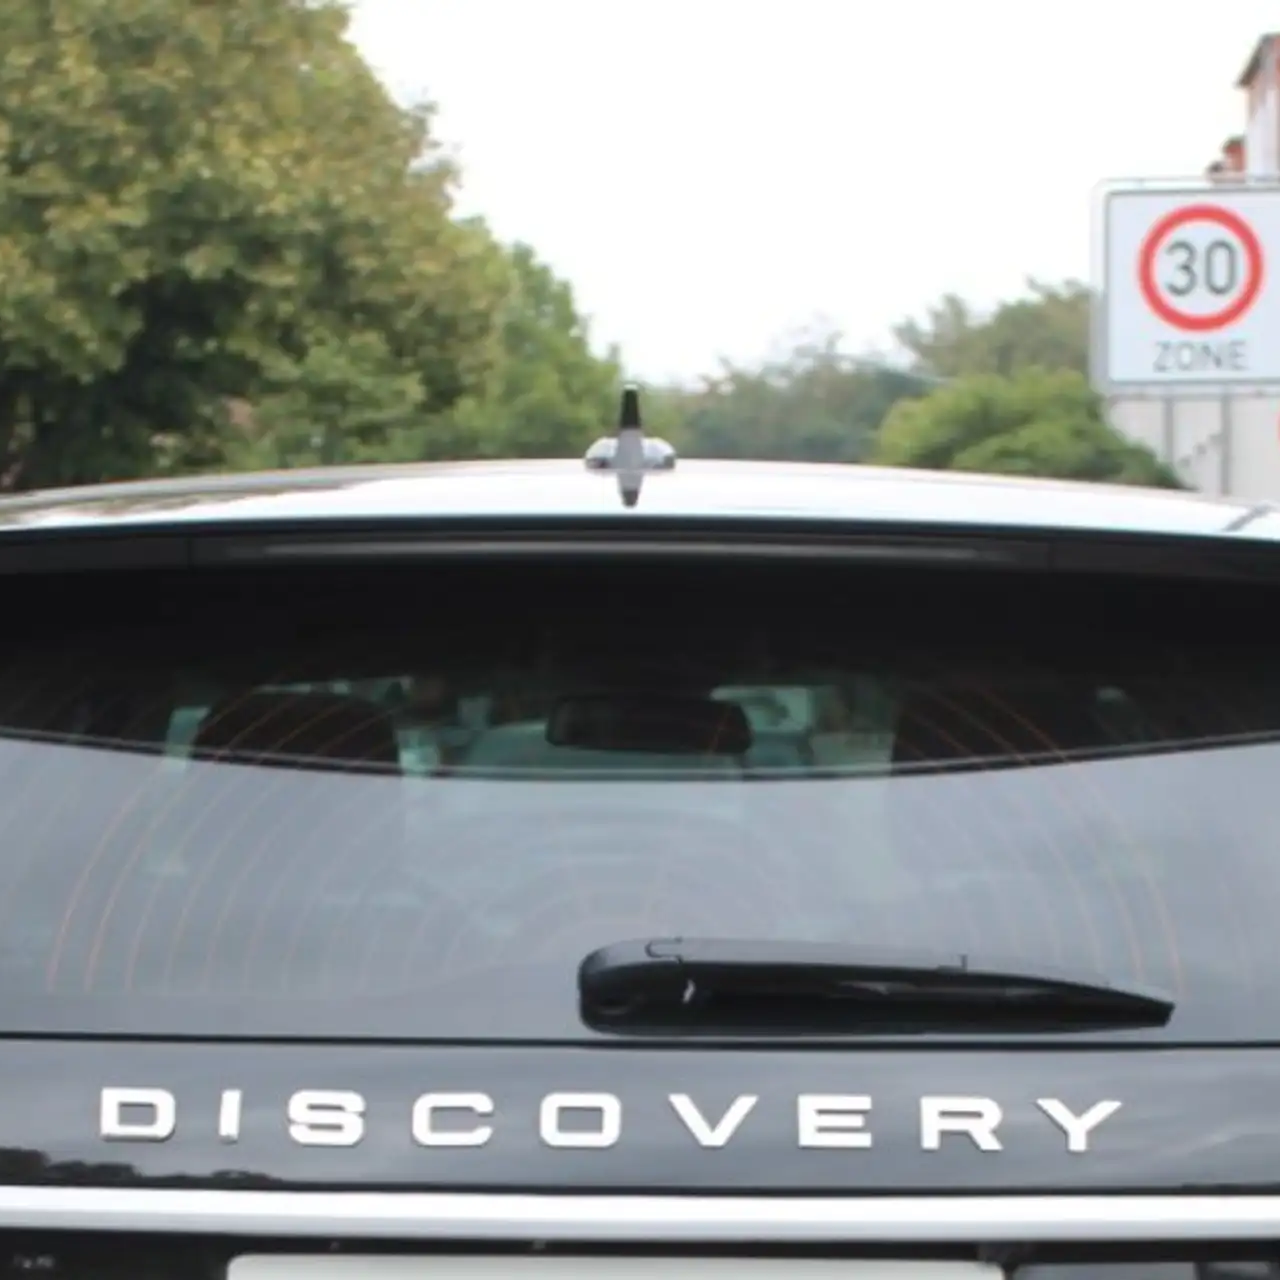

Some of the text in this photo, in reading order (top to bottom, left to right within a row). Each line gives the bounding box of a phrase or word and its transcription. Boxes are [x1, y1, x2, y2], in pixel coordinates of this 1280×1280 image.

[1165, 239, 1238, 297] 30
[1152, 340, 1249, 374] ZONE
[99, 1087, 1122, 1151] DISCOVERY
